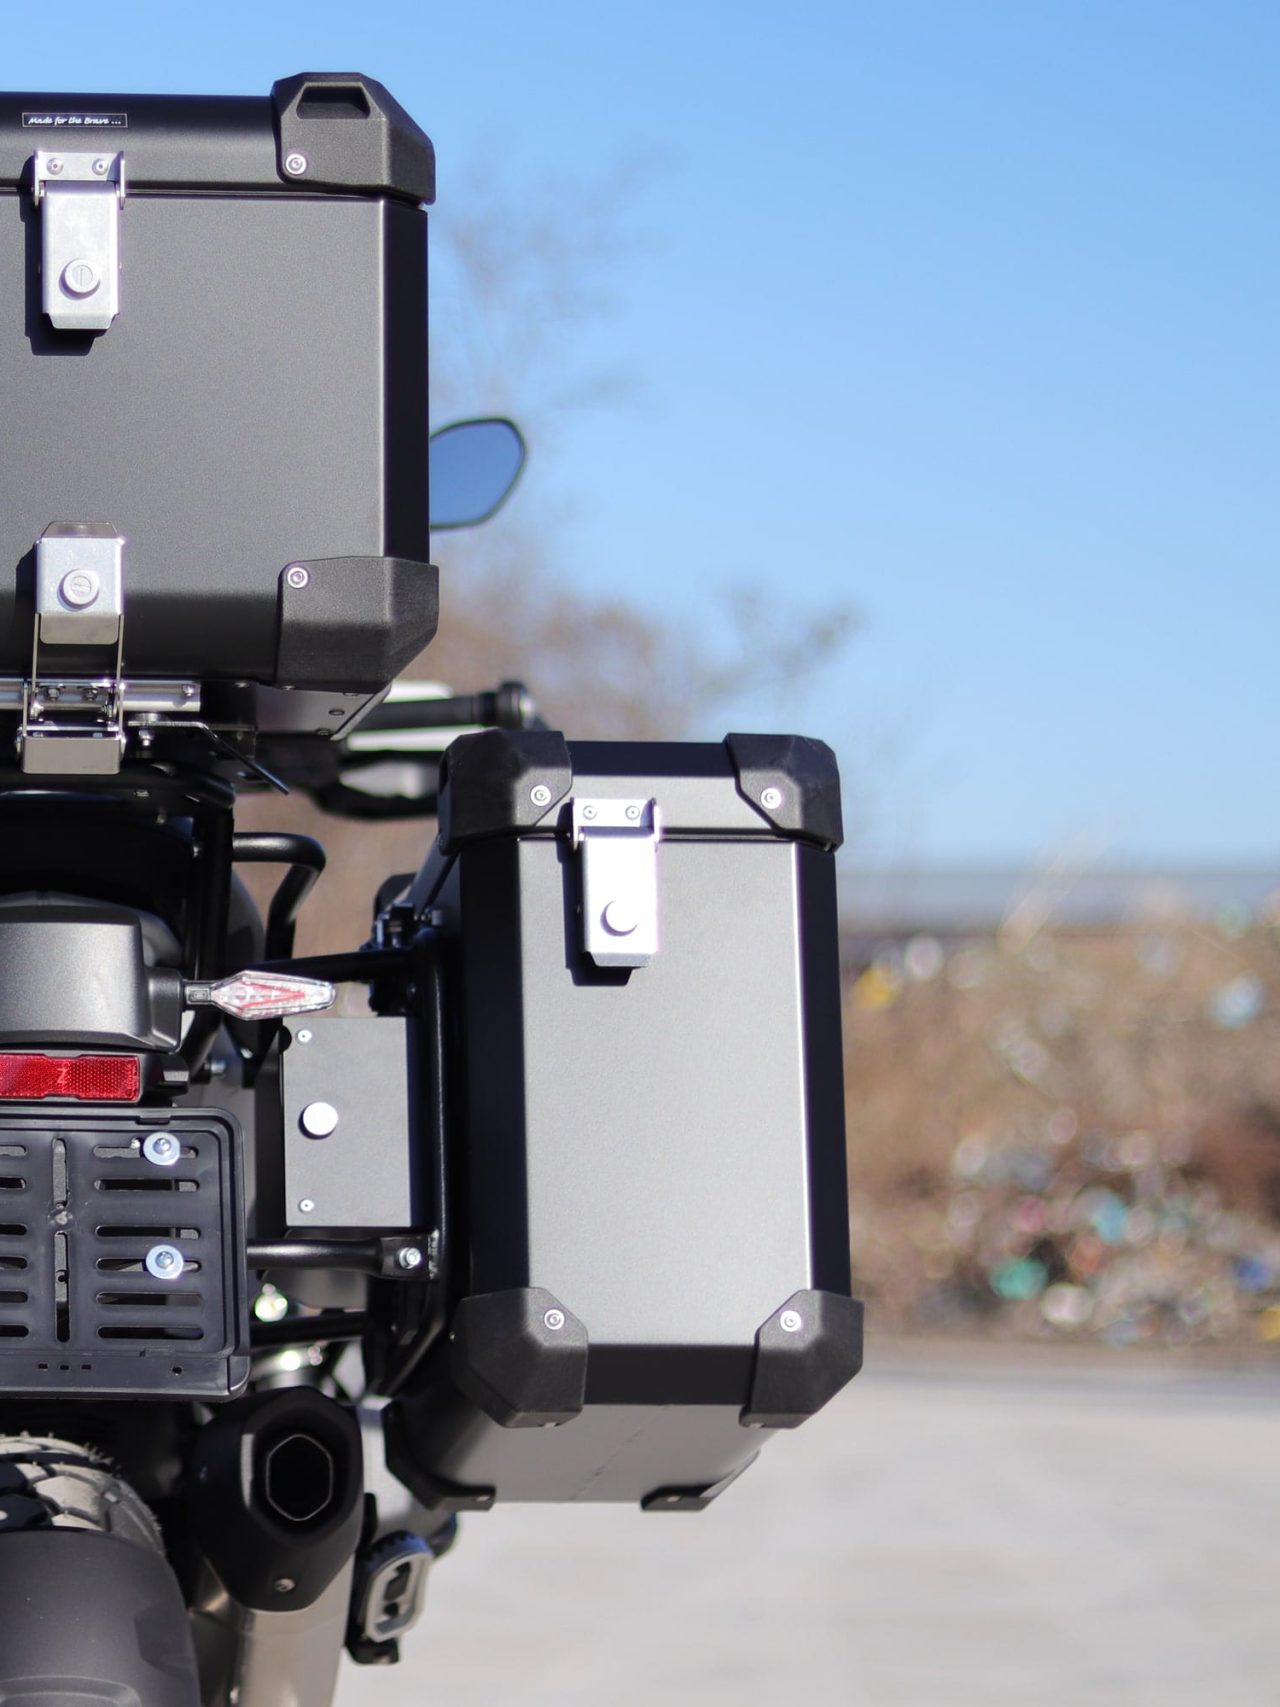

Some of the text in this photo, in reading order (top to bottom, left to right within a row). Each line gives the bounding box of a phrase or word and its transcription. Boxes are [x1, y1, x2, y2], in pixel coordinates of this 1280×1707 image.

[28, 116, 53, 124] Made
[54, 116, 68, 126] for
[68, 116, 82, 124] the
[84, 117, 109, 125] Brave
